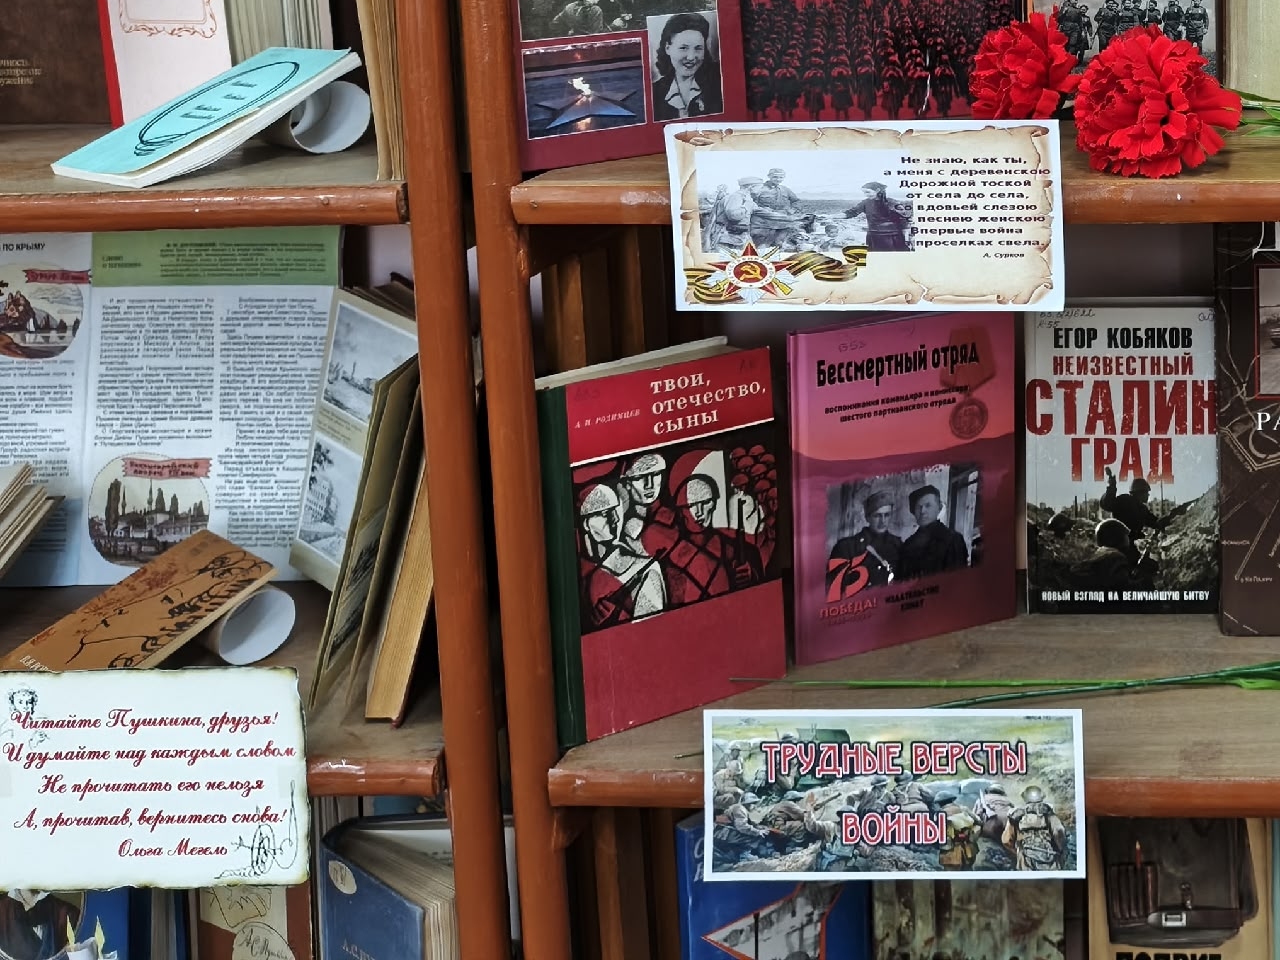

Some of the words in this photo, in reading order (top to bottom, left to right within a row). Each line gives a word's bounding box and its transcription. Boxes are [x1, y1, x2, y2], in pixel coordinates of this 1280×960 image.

[899, 179, 977, 189] Дорожной
[980, 179, 1032, 188] тоской
[1053, 327, 1098, 349] ЕГОР
[1107, 327, 1193, 349] КОБЯКОВ
[816, 344, 928, 387] Бессмертный
[931, 342, 980, 374] отряд
[1053, 352, 1193, 376] НЕИЗВЕСТНЫЙ
[1025, 378, 1217, 437] СТАЛИН
[1070, 437, 1175, 484] ГРАД
[826, 549, 869, 603] 75
[1041, 590, 1071, 602] НОВЫЙ
[1073, 590, 1105, 603] ВЗГЛЯД
[1122, 589, 1180, 602] ВЕЛИЧАЙШУЮ
[1183, 590, 1210, 602] БИТВУ
[10, 709, 102, 733] Читайте
[105, 707, 206, 734] Пушкина,
[207, 710, 280, 736] друзья!
[23, 745, 111, 770] думайте
[150, 745, 233, 765] каждым
[235, 742, 297, 760] словом
[761, 742, 903, 783] ТРУДНЫЕ
[913, 740, 1028, 776] ВЕРСТЫ
[71, 779, 173, 801] прочитать
[203, 777, 265, 799] нельзя
[42, 806, 134, 837] прочитав,
[137, 806, 228, 835] вернитесь
[231, 806, 288, 826] снова!
[842, 806, 947, 845] ВОЙНЫ
[118, 838, 165, 858] Ольга
[166, 838, 229, 858] Мегель
